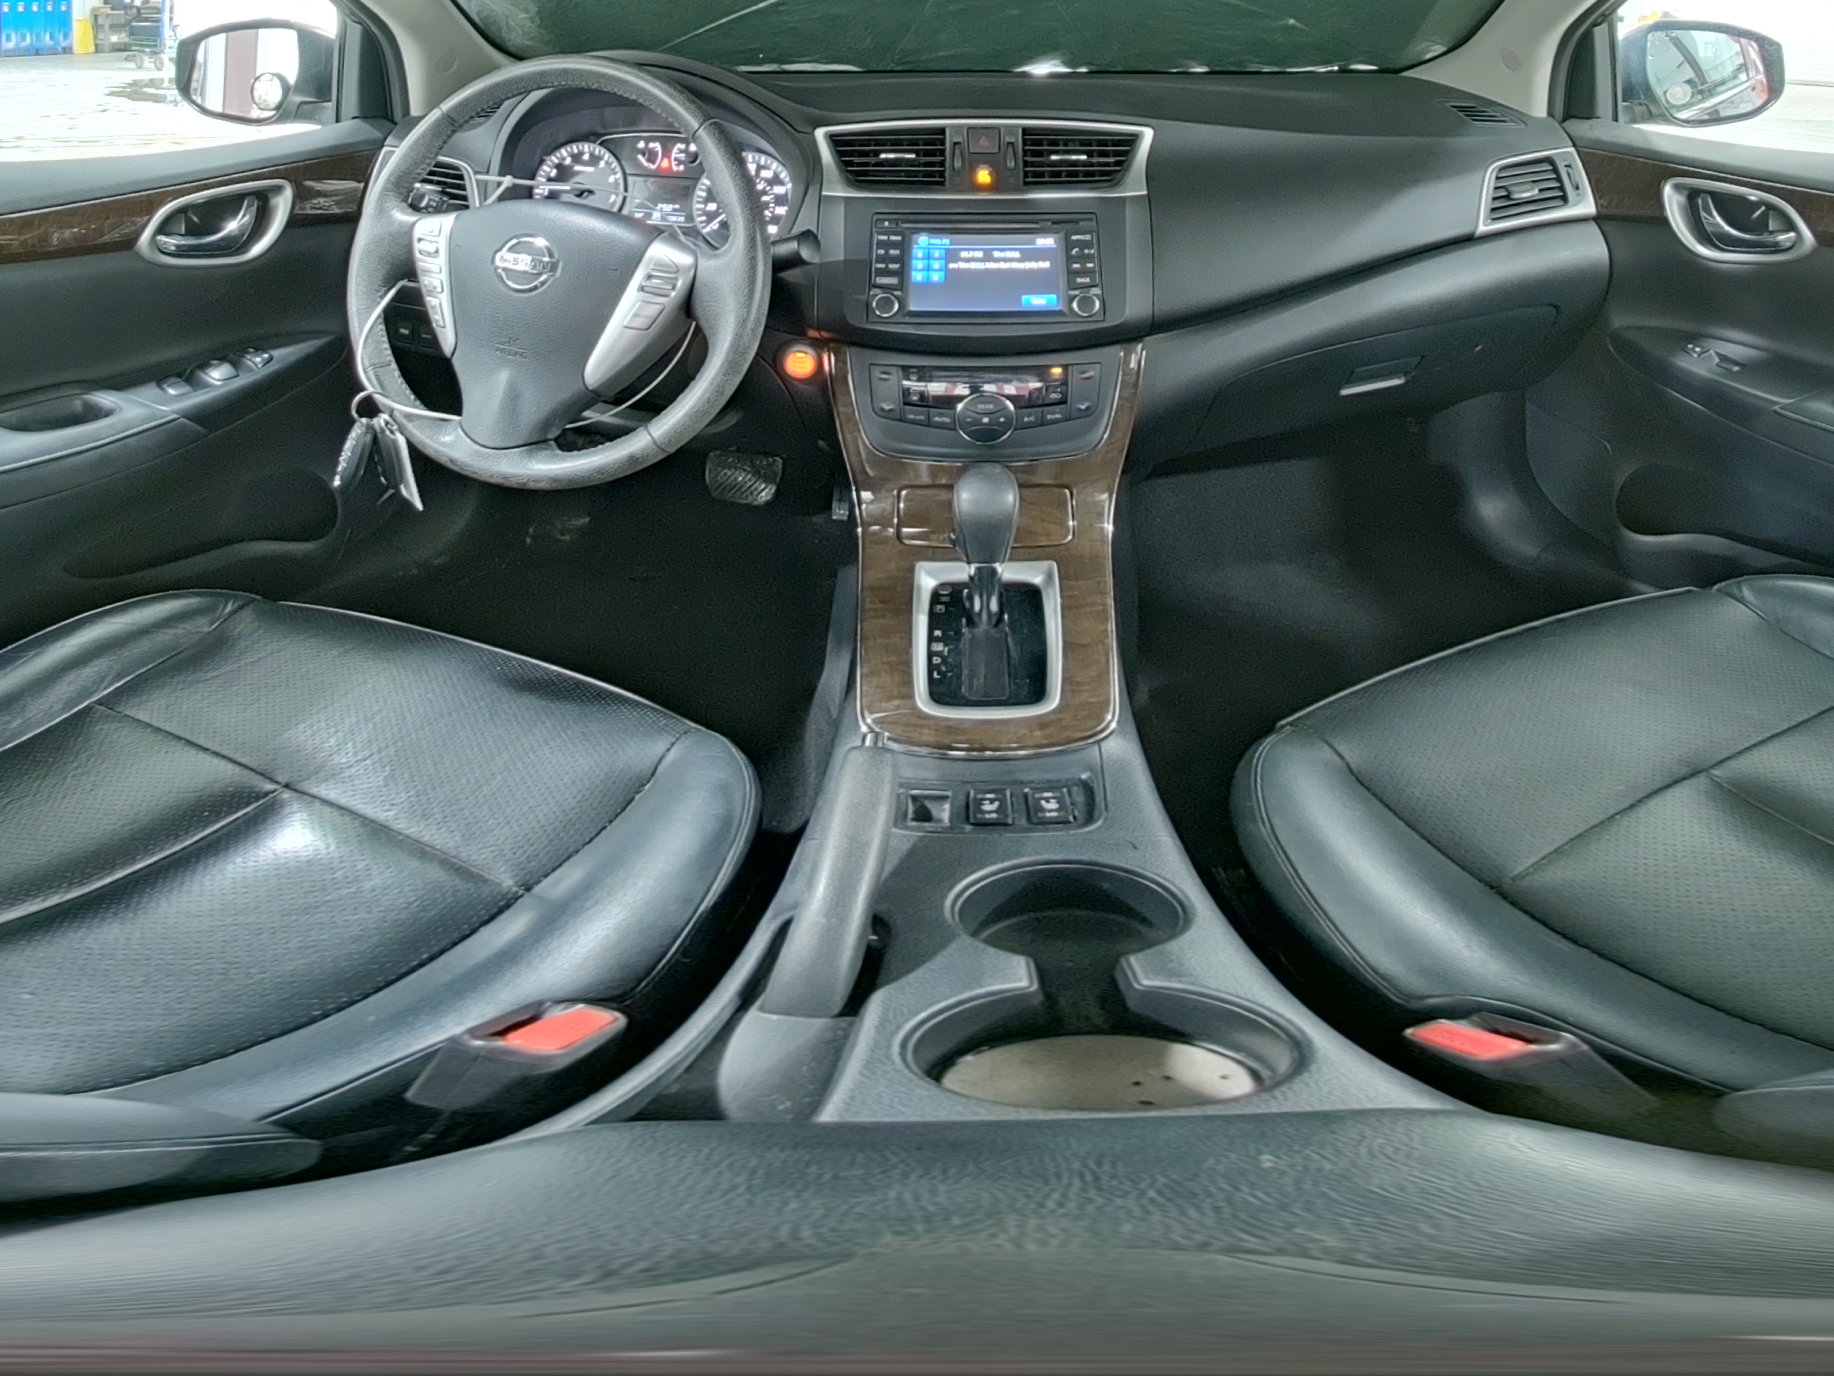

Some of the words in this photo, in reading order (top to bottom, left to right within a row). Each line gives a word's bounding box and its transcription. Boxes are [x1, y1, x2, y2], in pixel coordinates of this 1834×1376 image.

[498, 254, 553, 273] NISSAN
[933, 629, 942, 637] R
[932, 656, 942, 664] D
[933, 670, 942, 678] L
